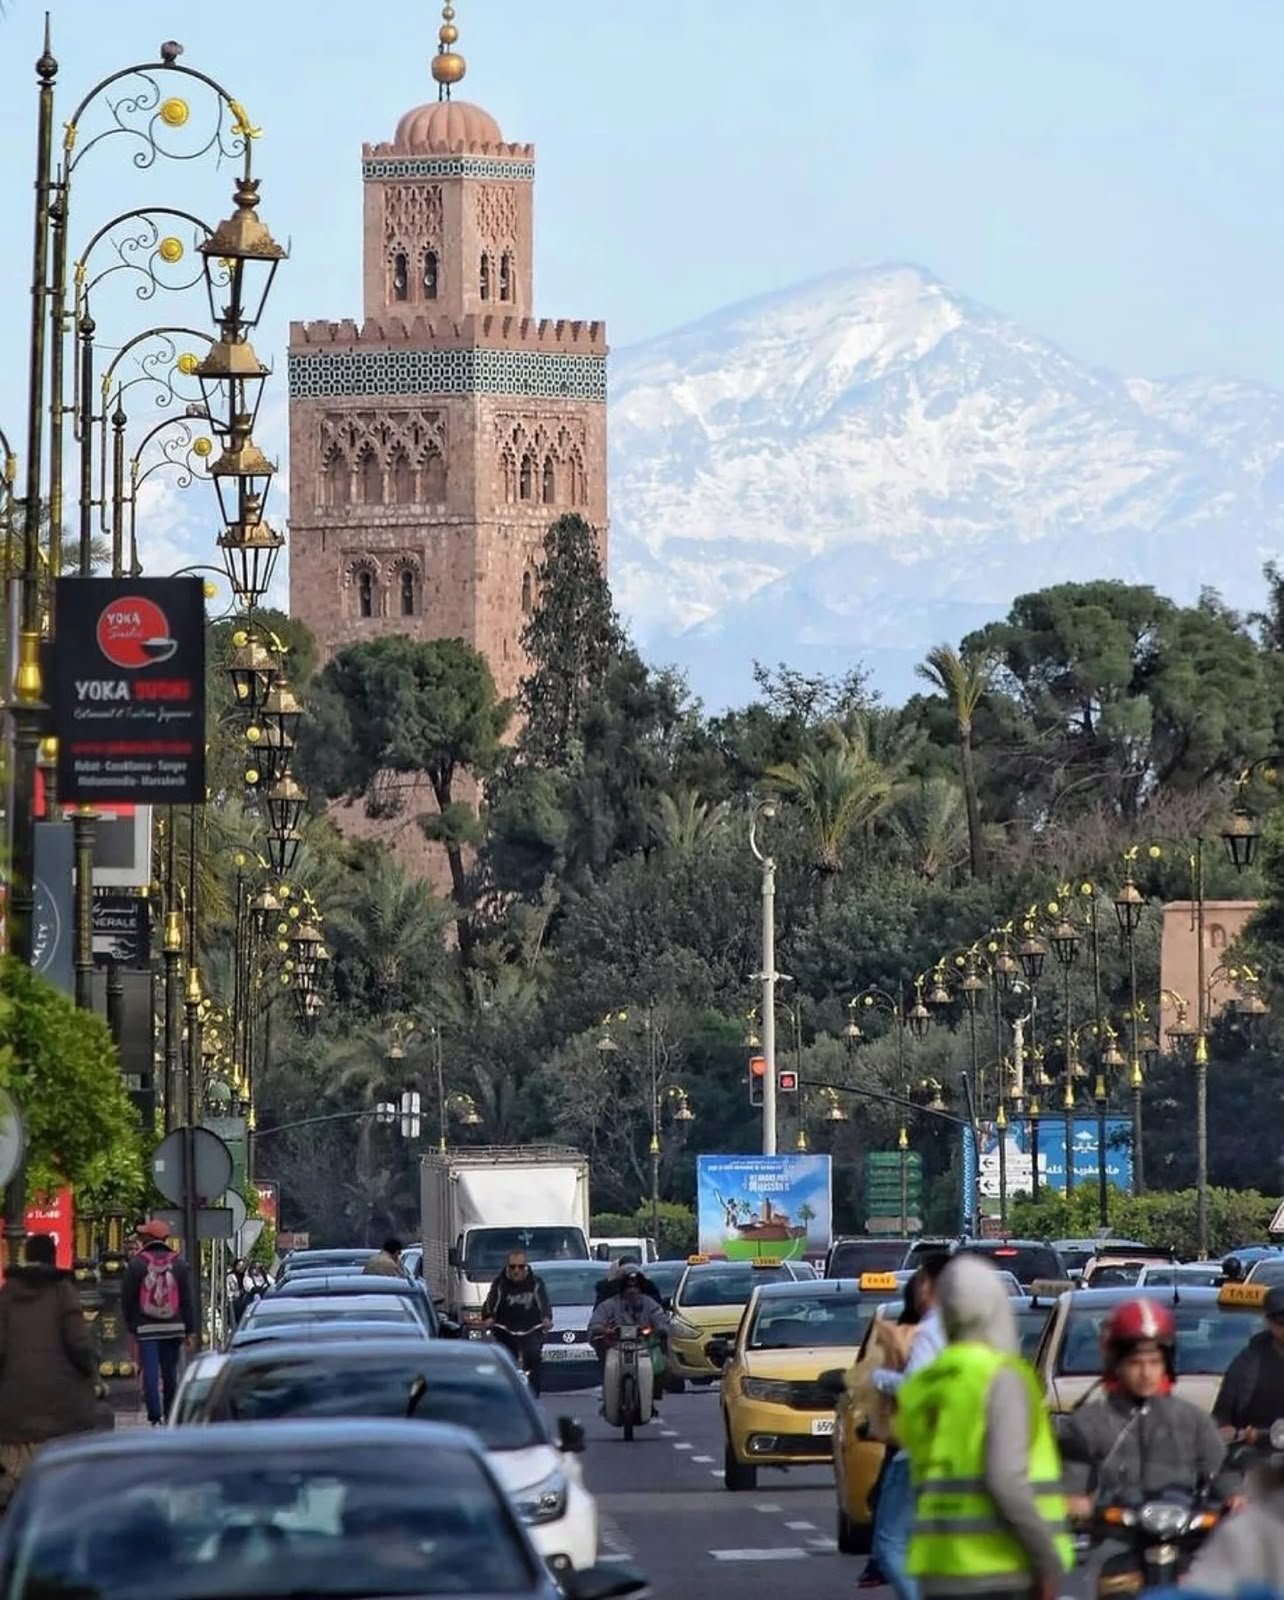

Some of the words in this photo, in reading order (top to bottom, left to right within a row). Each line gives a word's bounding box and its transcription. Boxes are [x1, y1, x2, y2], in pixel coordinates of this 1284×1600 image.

[107, 611, 141, 625] YOKA
[75, 680, 131, 701] YOKA
[92, 918, 137, 928] NERALE
[1226, 1288, 1260, 1300] TAXI
